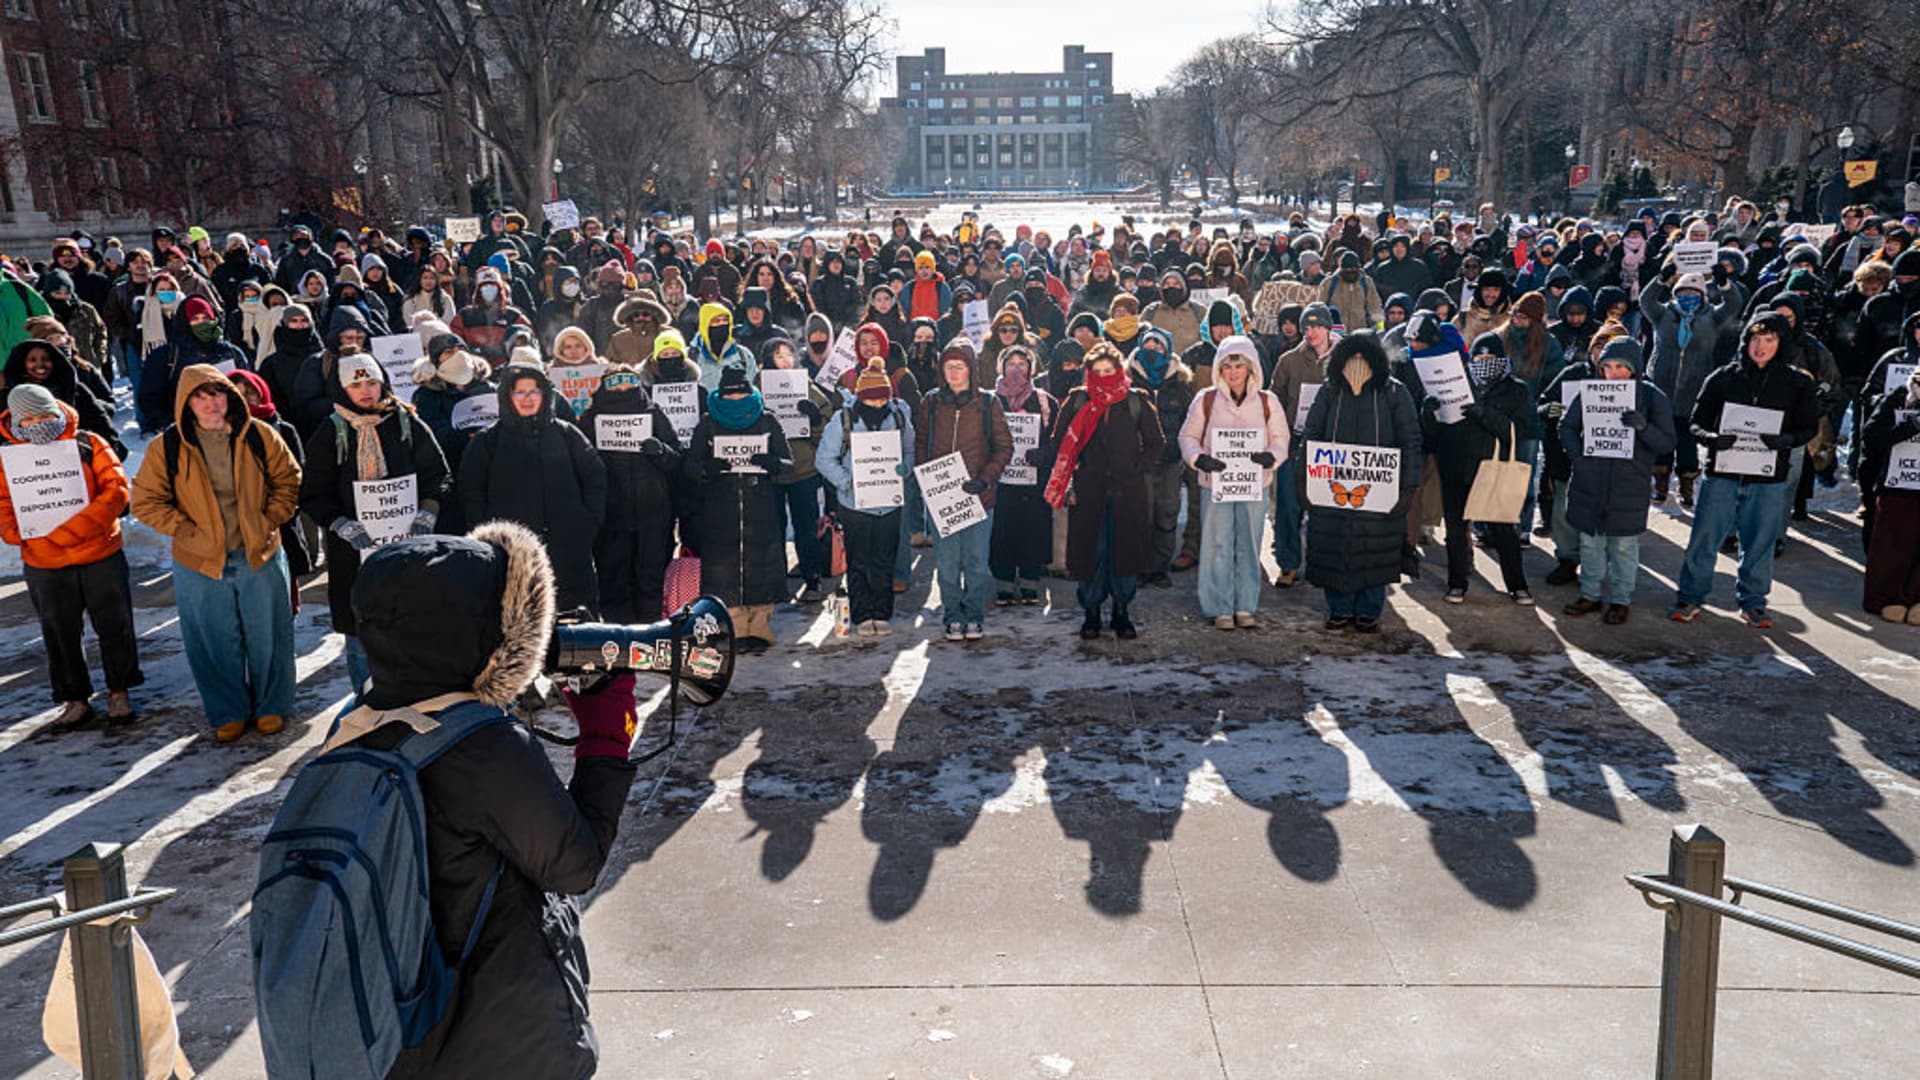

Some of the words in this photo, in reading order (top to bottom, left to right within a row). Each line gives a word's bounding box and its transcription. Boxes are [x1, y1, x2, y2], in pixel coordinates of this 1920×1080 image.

[1263, 285, 1320, 302] FASCISM
[657, 384, 692, 394] PROTECT
[1587, 384, 1627, 392] PROTECT
[668, 395, 682, 404] THE
[1599, 395, 1615, 403] THE
[601, 418, 643, 428] PROTECT
[1218, 430, 1257, 438] PROTECT
[1592, 427, 1607, 437] ICE
[1608, 428, 1629, 438] OUT
[601, 440, 642, 448] STUDENT
[1229, 440, 1246, 448] THE
[1595, 440, 1622, 450] NOW!
[722, 446, 738, 455] ICE
[740, 445, 762, 455] OUT
[35, 459, 50, 467] NO
[1314, 448, 1347, 465] MN
[1351, 450, 1398, 469] STANDS
[1899, 458, 1917, 468] ICE
[920, 457, 957, 476] PROTECT
[12, 470, 80, 484] COOPERATION
[934, 471, 951, 482] THE
[1236, 472, 1257, 481] OUT
[1307, 464, 1333, 479] WITH
[1334, 467, 1393, 484] IMMIGRANTS
[37, 487, 62, 496] WITH
[361, 479, 410, 494] PROTECT
[1222, 485, 1252, 495] NOW!
[20, 498, 84, 512] DEPORTATION
[378, 494, 398, 506] THE
[361, 504, 415, 520] STUDENTS
[938, 505, 954, 518] ICE
[954, 497, 975, 511] OUT
[946, 509, 974, 527] NOW!
